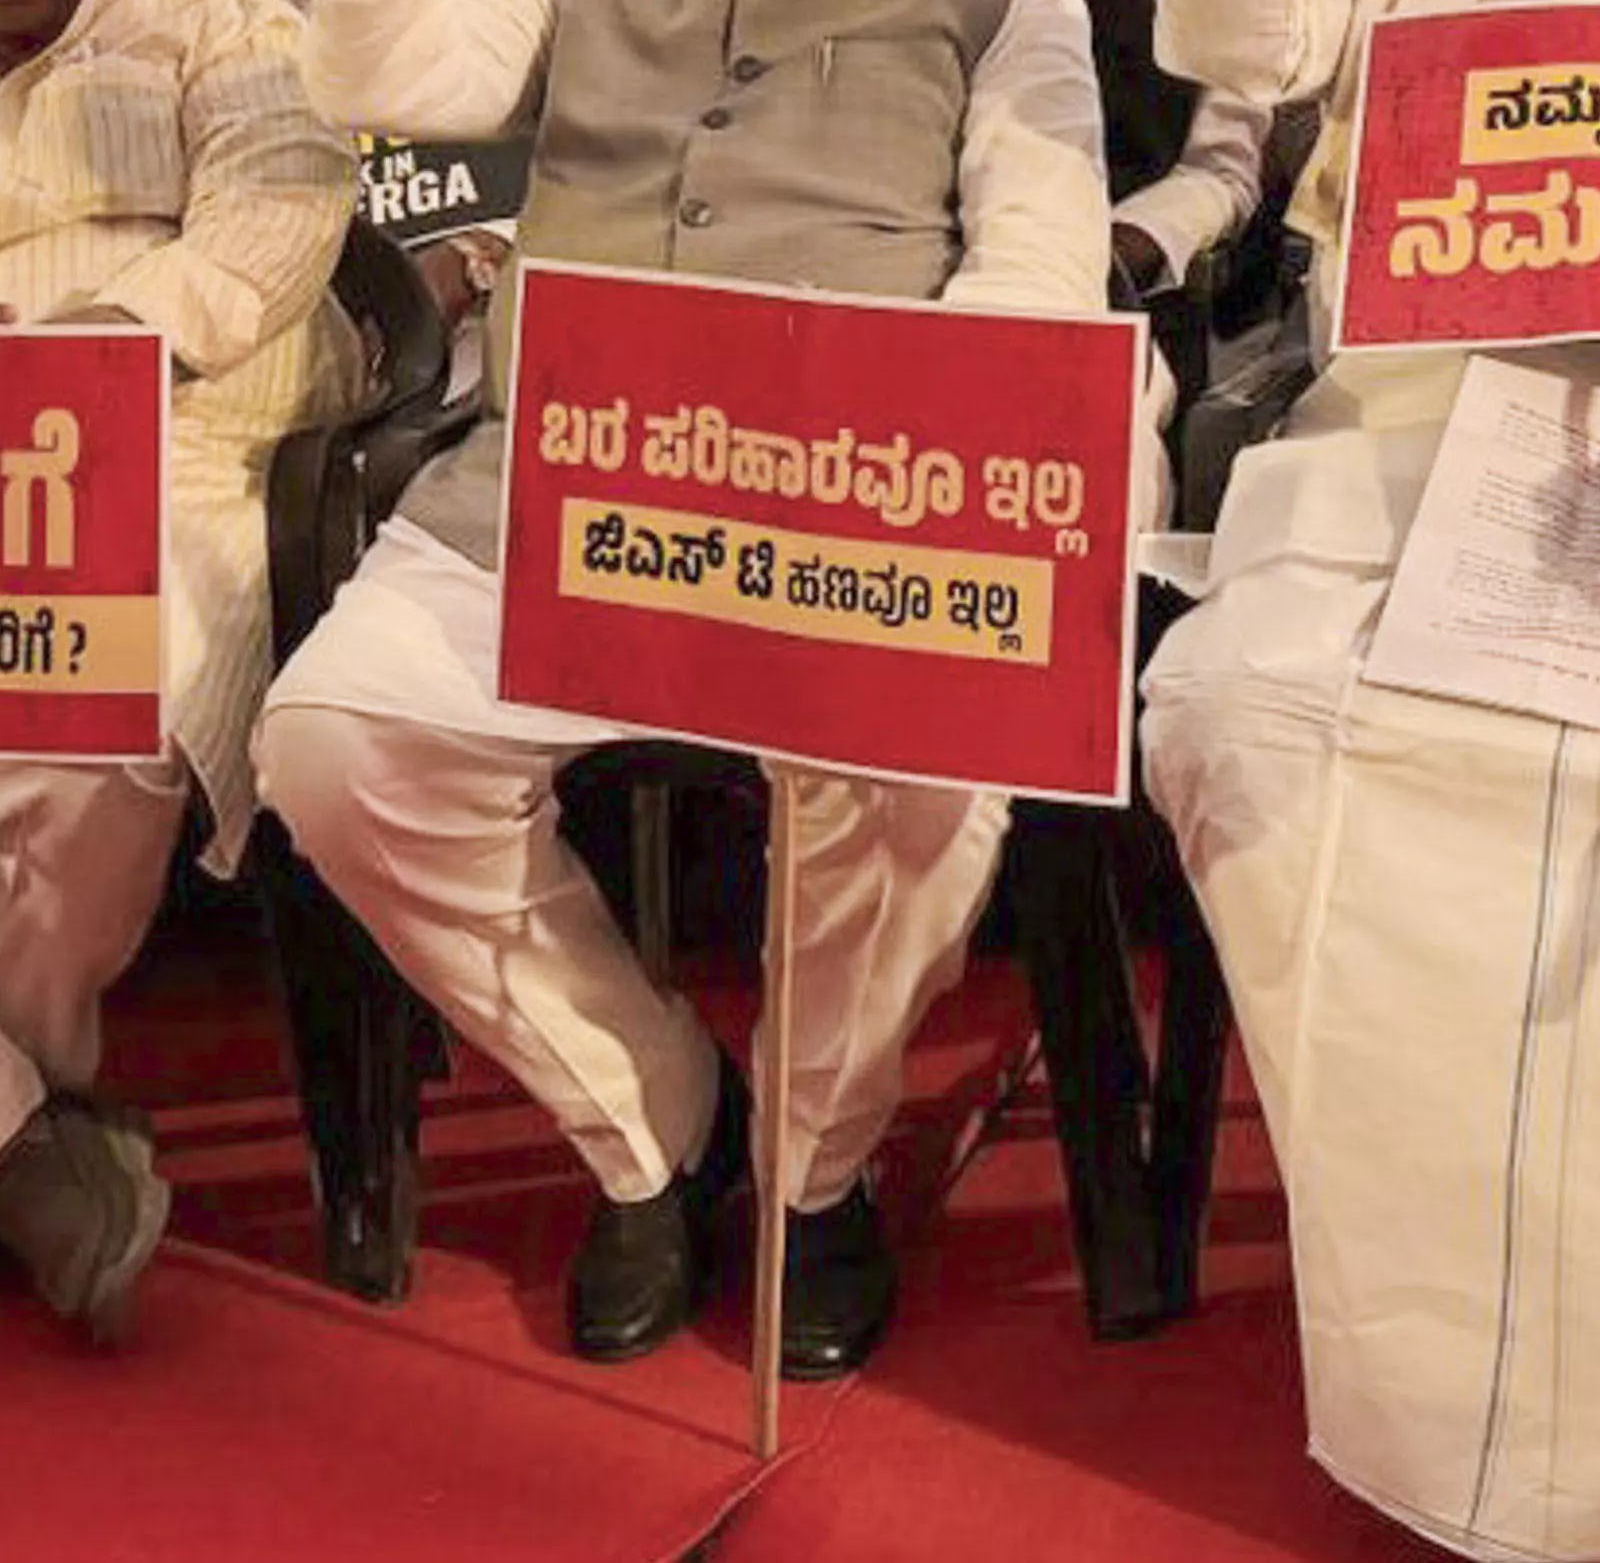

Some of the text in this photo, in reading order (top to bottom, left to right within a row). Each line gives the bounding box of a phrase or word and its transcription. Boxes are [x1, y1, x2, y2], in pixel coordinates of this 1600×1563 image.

[383, 150, 415, 181] IN
[539, 399, 1089, 560] ಬರ ಪರಿಹಾರವೂ ಇಲ್ಲ
[738, 539, 774, 598] ಟಿ
[787, 558, 934, 627] ಹಣವೂ
[948, 576, 1022, 652] ಇಲ್ಲ
